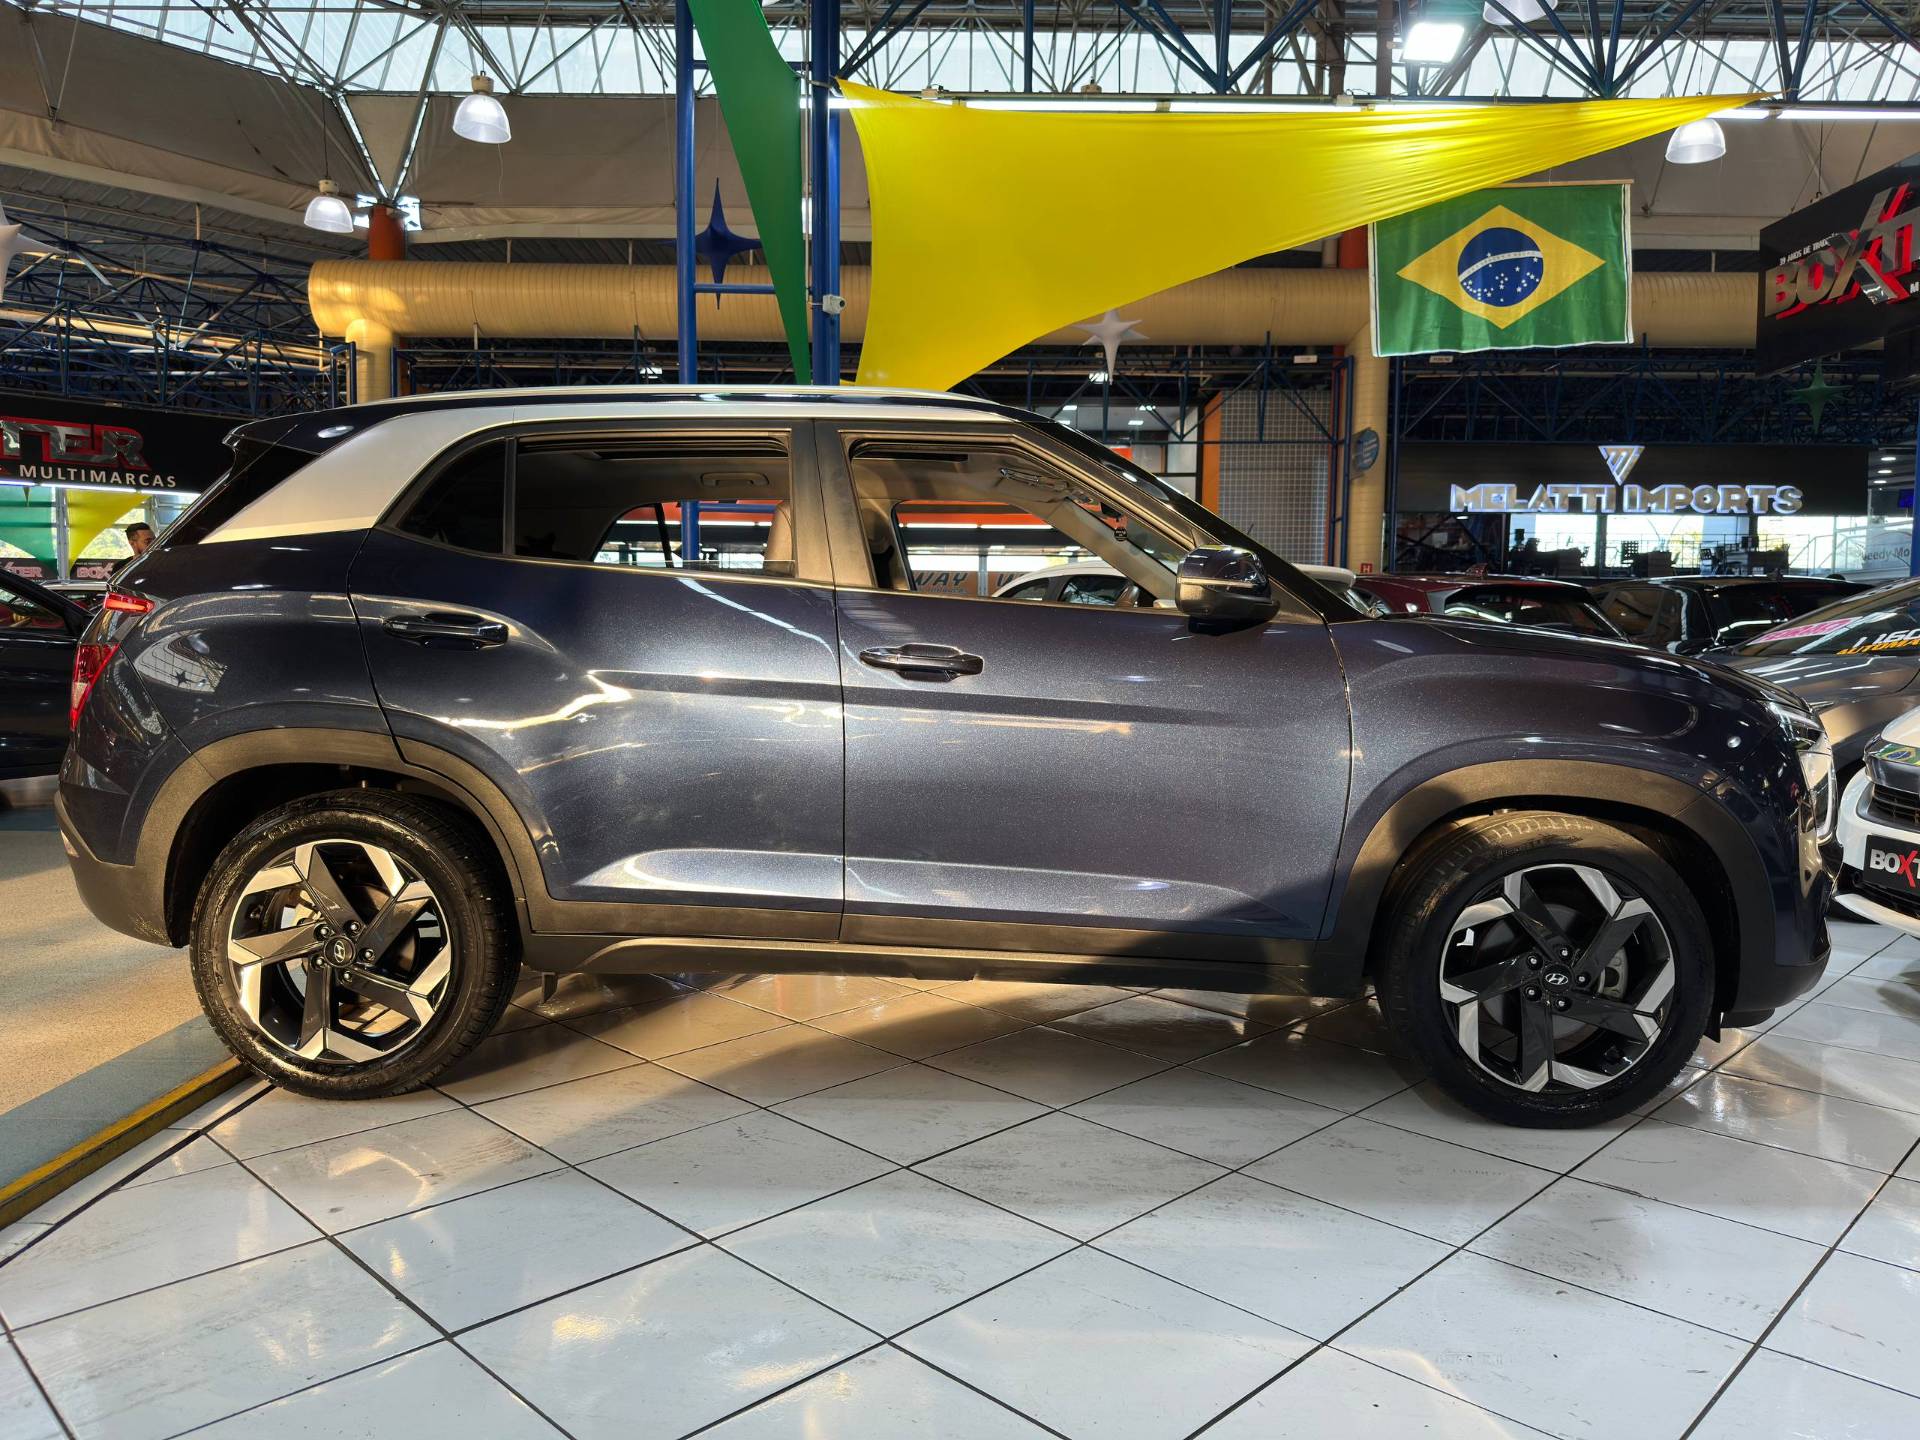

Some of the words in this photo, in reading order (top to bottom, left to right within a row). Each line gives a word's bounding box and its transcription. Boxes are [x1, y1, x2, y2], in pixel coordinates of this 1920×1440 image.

[19, 464, 177, 488] MULTIMARCAS
[1450, 483, 1616, 513] MELATTI
[1622, 484, 1803, 514] IMPORTS
